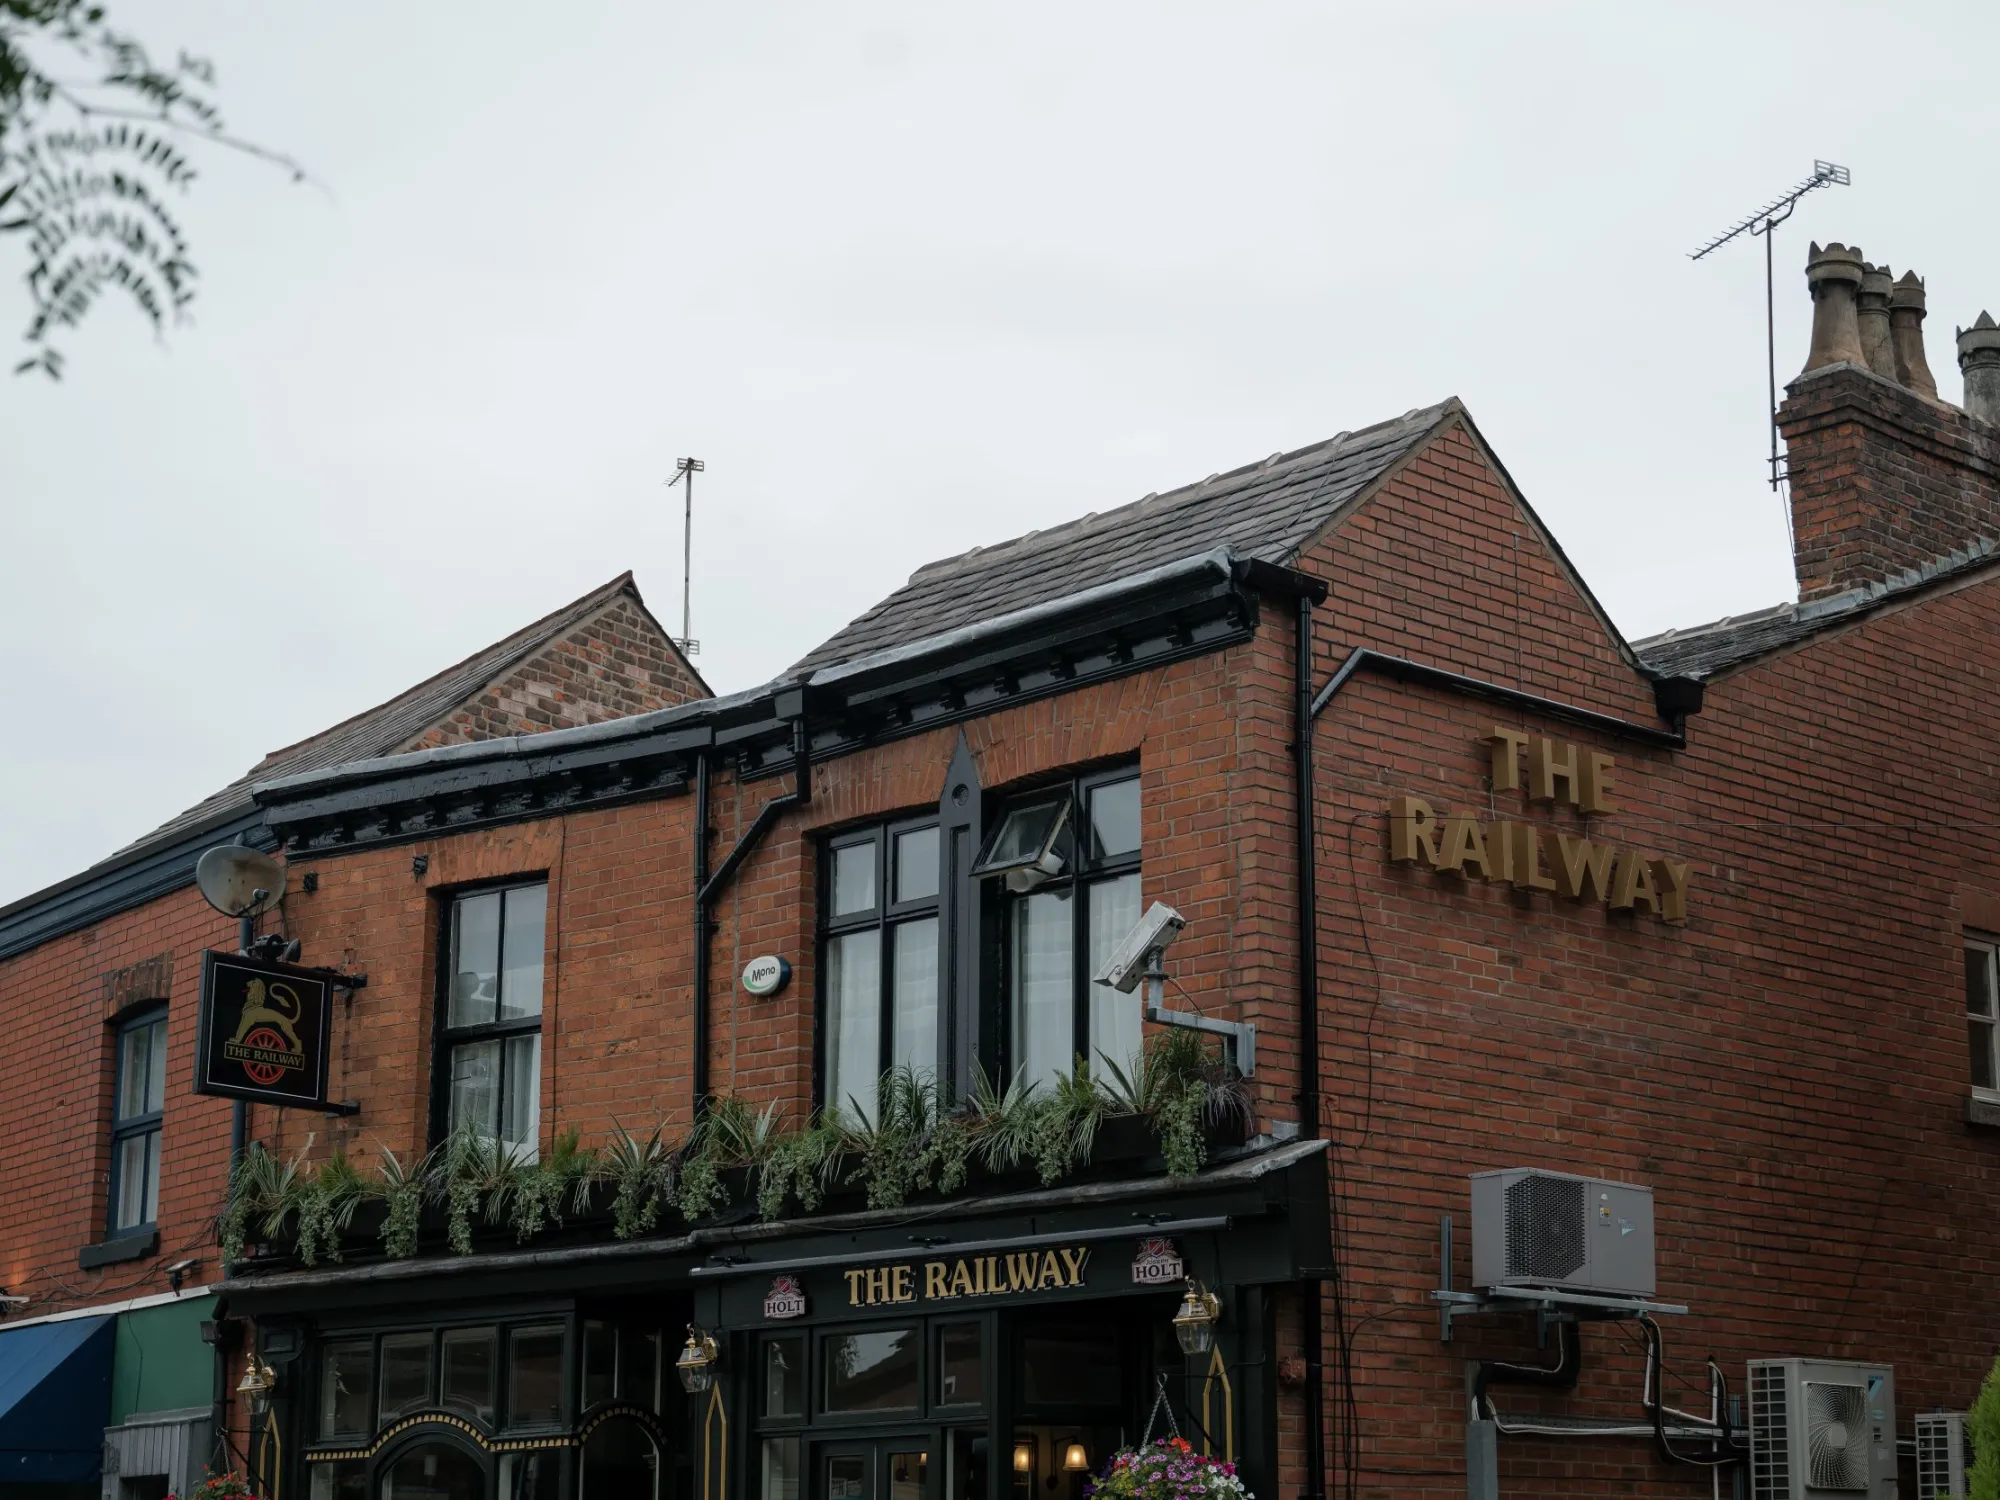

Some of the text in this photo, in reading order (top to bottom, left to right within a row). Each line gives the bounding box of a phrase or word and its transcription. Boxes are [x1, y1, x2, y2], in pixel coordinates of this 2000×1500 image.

[1479, 725, 1618, 816] THE
[1389, 795, 1694, 926] RAILWAY
[752, 966, 776, 982] Mono
[227, 1045, 302, 1066] THE RAILWAY
[844, 1247, 1089, 1305] THE RAILWAY
[1135, 1262, 1180, 1279] HOLT
[766, 1300, 802, 1314] HOLT
